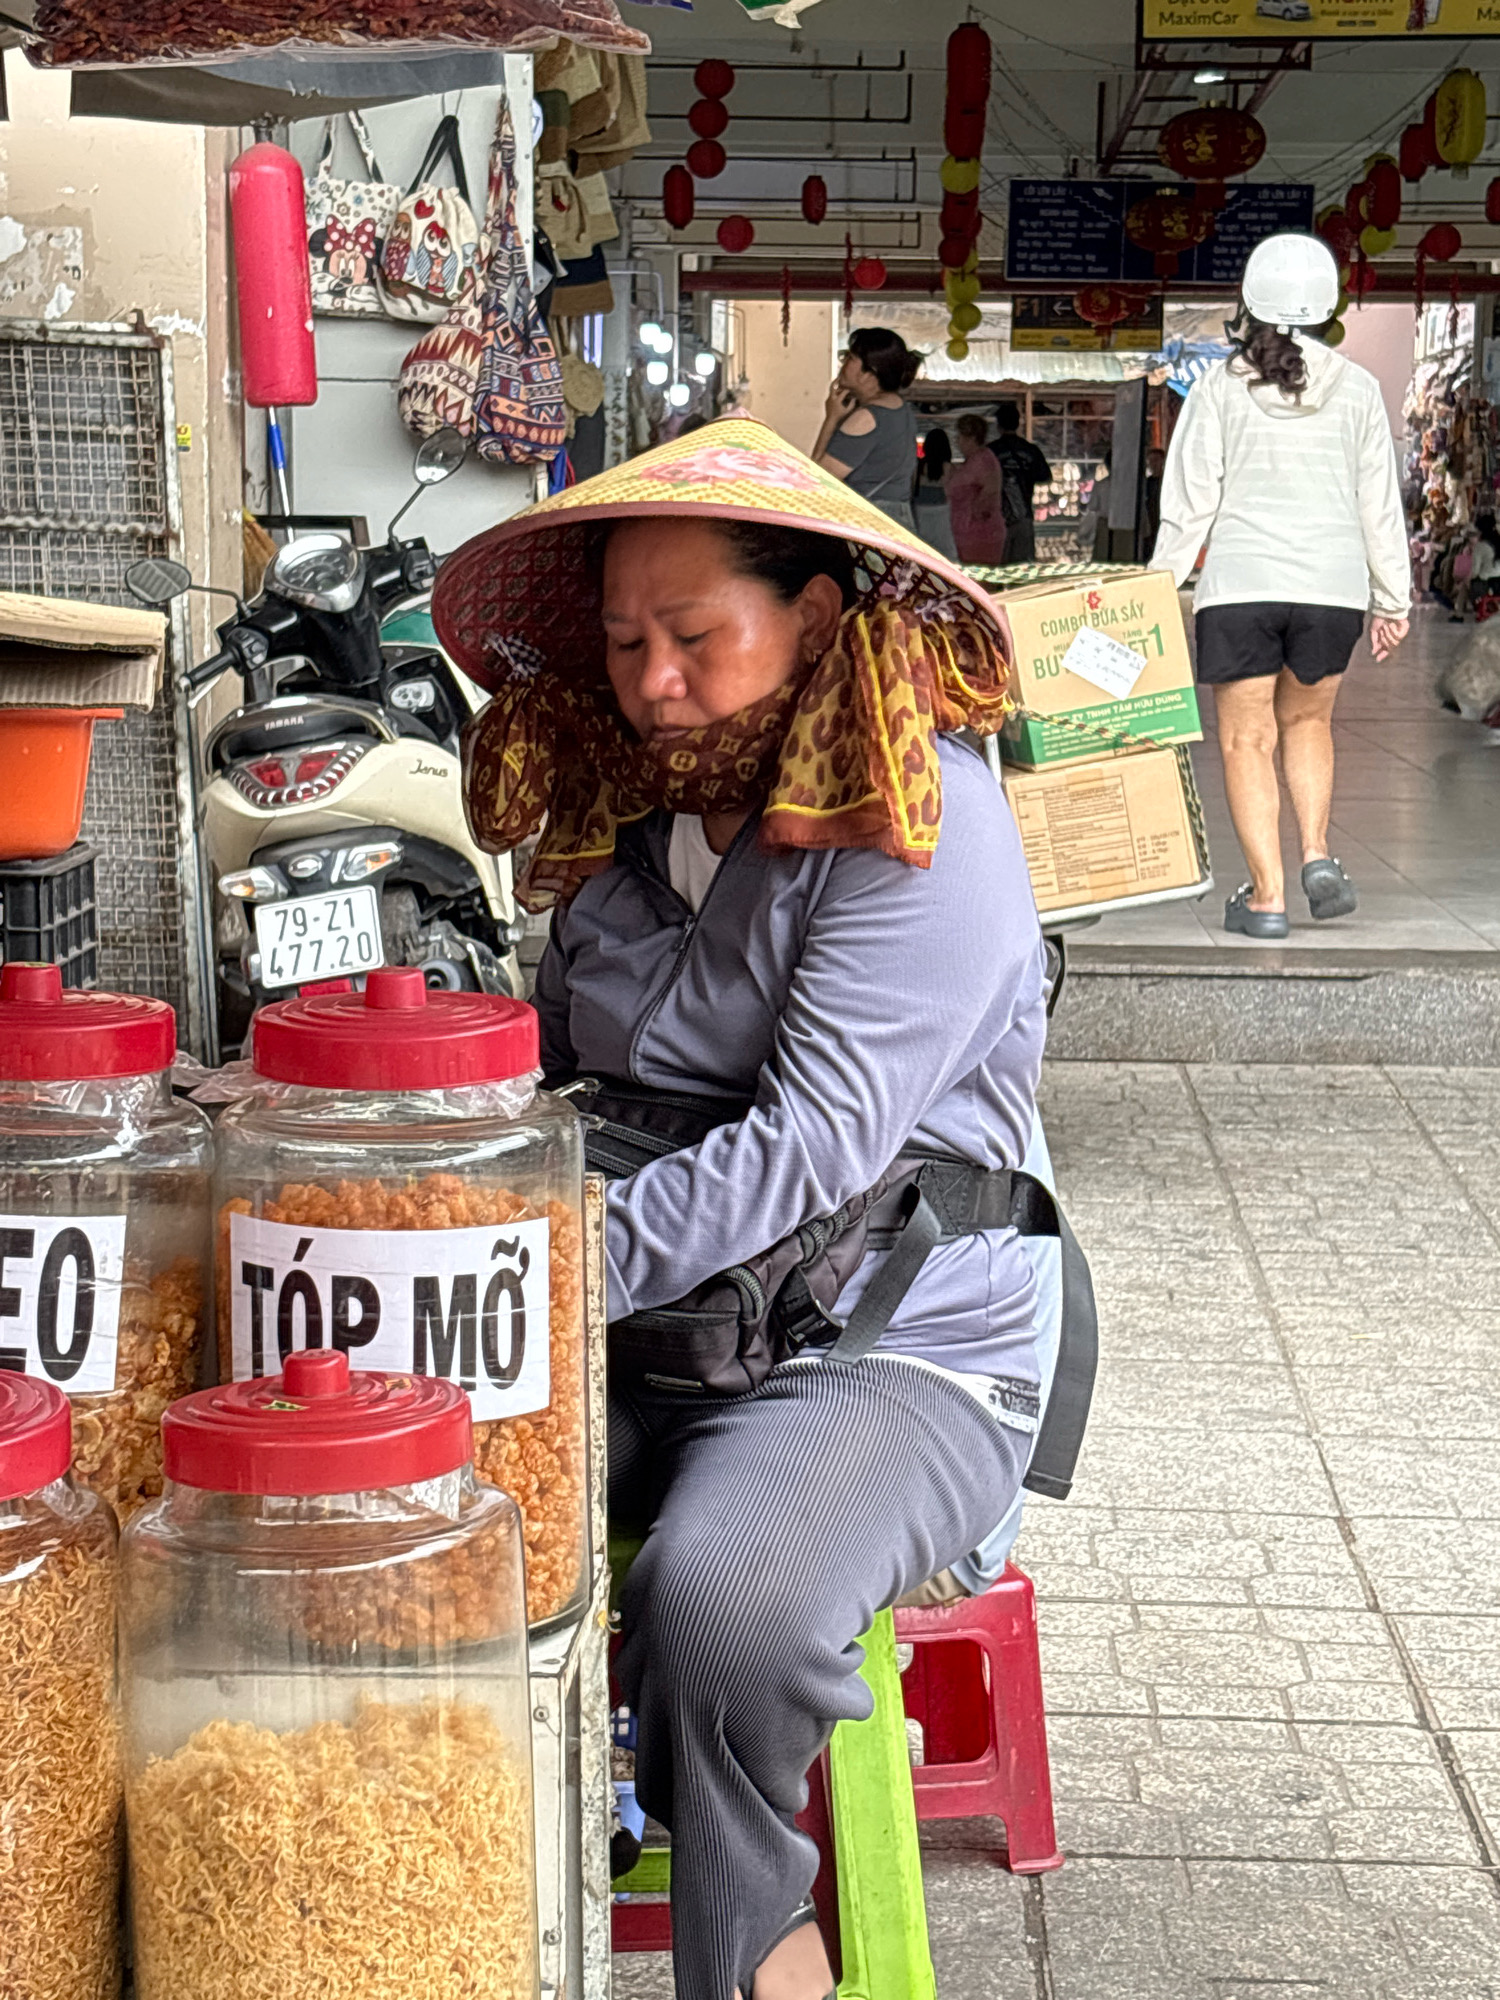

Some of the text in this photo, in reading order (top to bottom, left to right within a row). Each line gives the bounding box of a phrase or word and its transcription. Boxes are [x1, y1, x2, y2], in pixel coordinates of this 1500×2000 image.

[1158, 11, 1239, 26] MaximCar
[1015, 297, 1040, 317] F1
[1040, 614, 1087, 637] COMBO
[1147, 623, 1164, 657] 1
[264, 715, 305, 732] YAMAHA
[408, 758, 449, 778] Janus
[274, 897, 355, 942] 79-Z1
[270, 931, 373, 979] 477.20
[241, 1235, 531, 1391] TÓP MỠ
